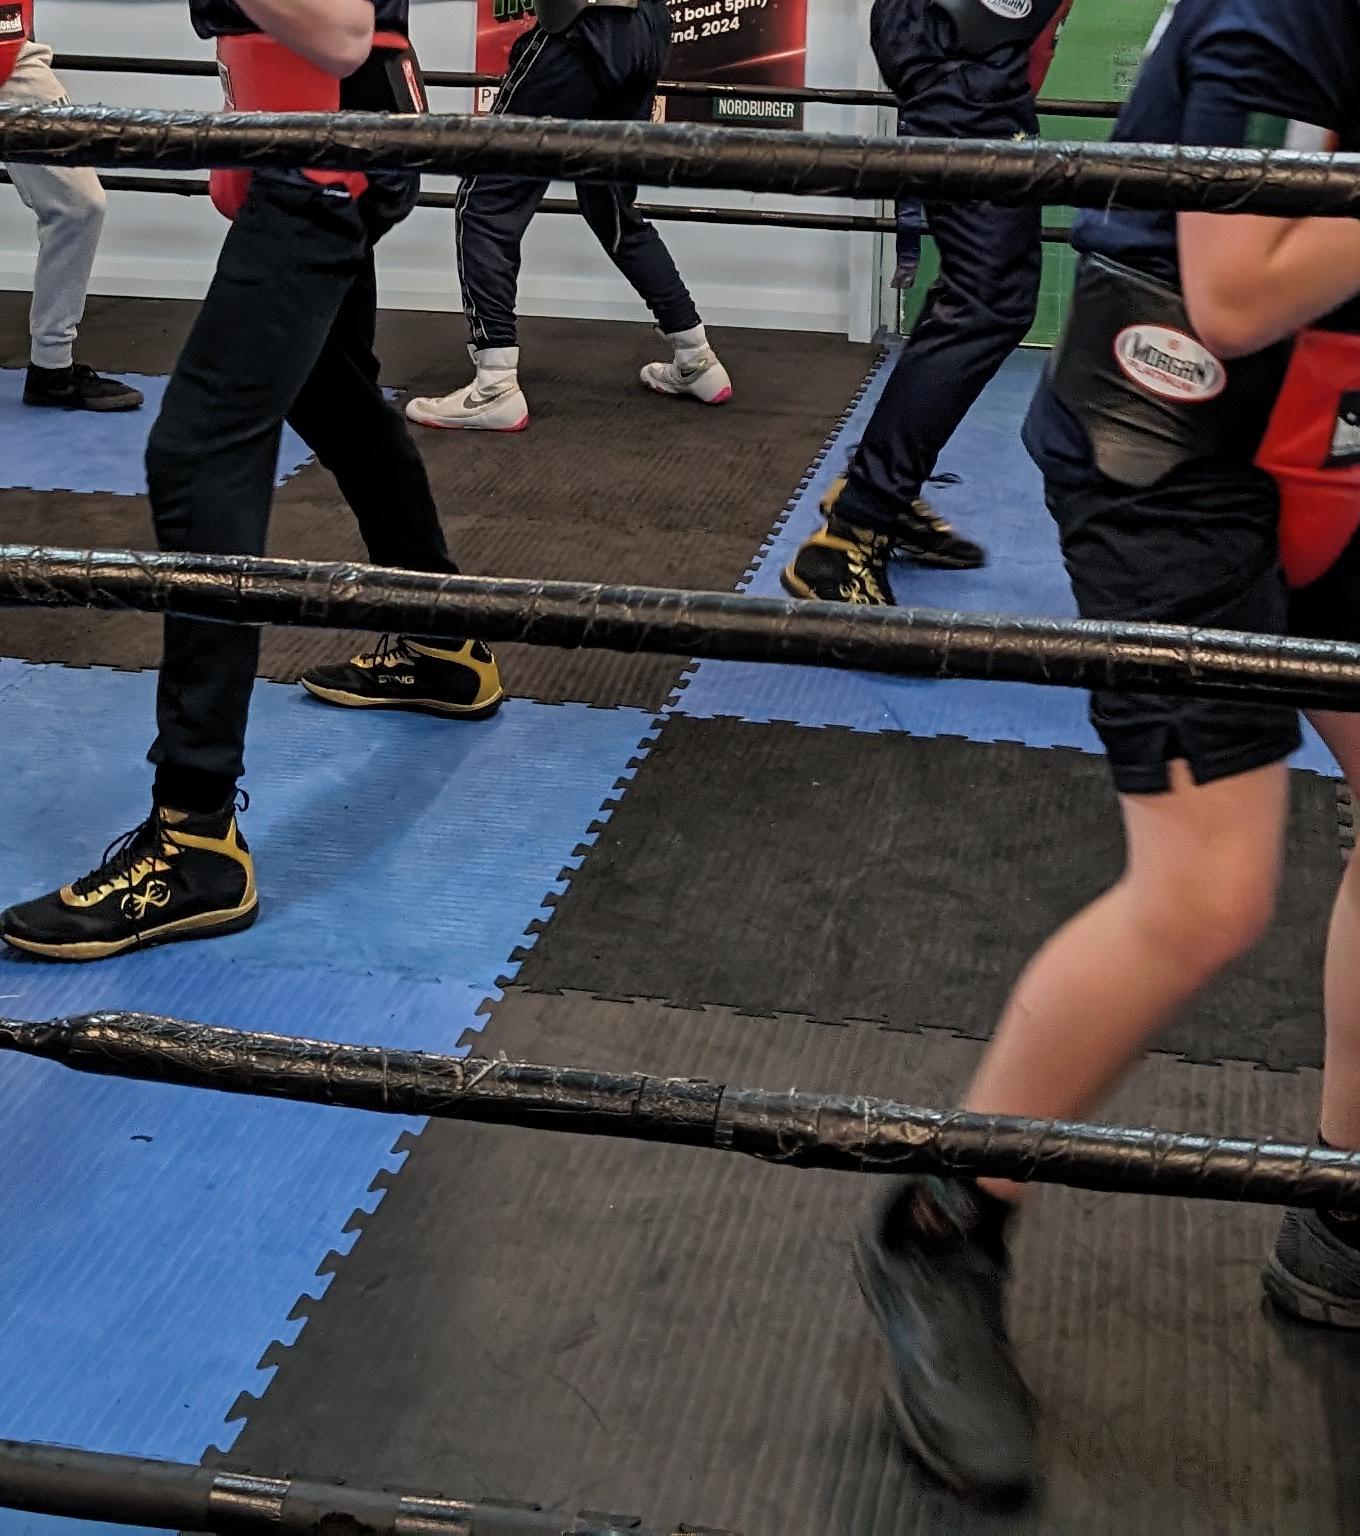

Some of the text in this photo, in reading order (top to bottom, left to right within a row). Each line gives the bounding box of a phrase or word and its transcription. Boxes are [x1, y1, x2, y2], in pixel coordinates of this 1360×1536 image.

[685, 2, 721, 22] bout
[671, 16, 741, 44] nd, 2024
[719, 98, 795, 118] NORDBURGER
